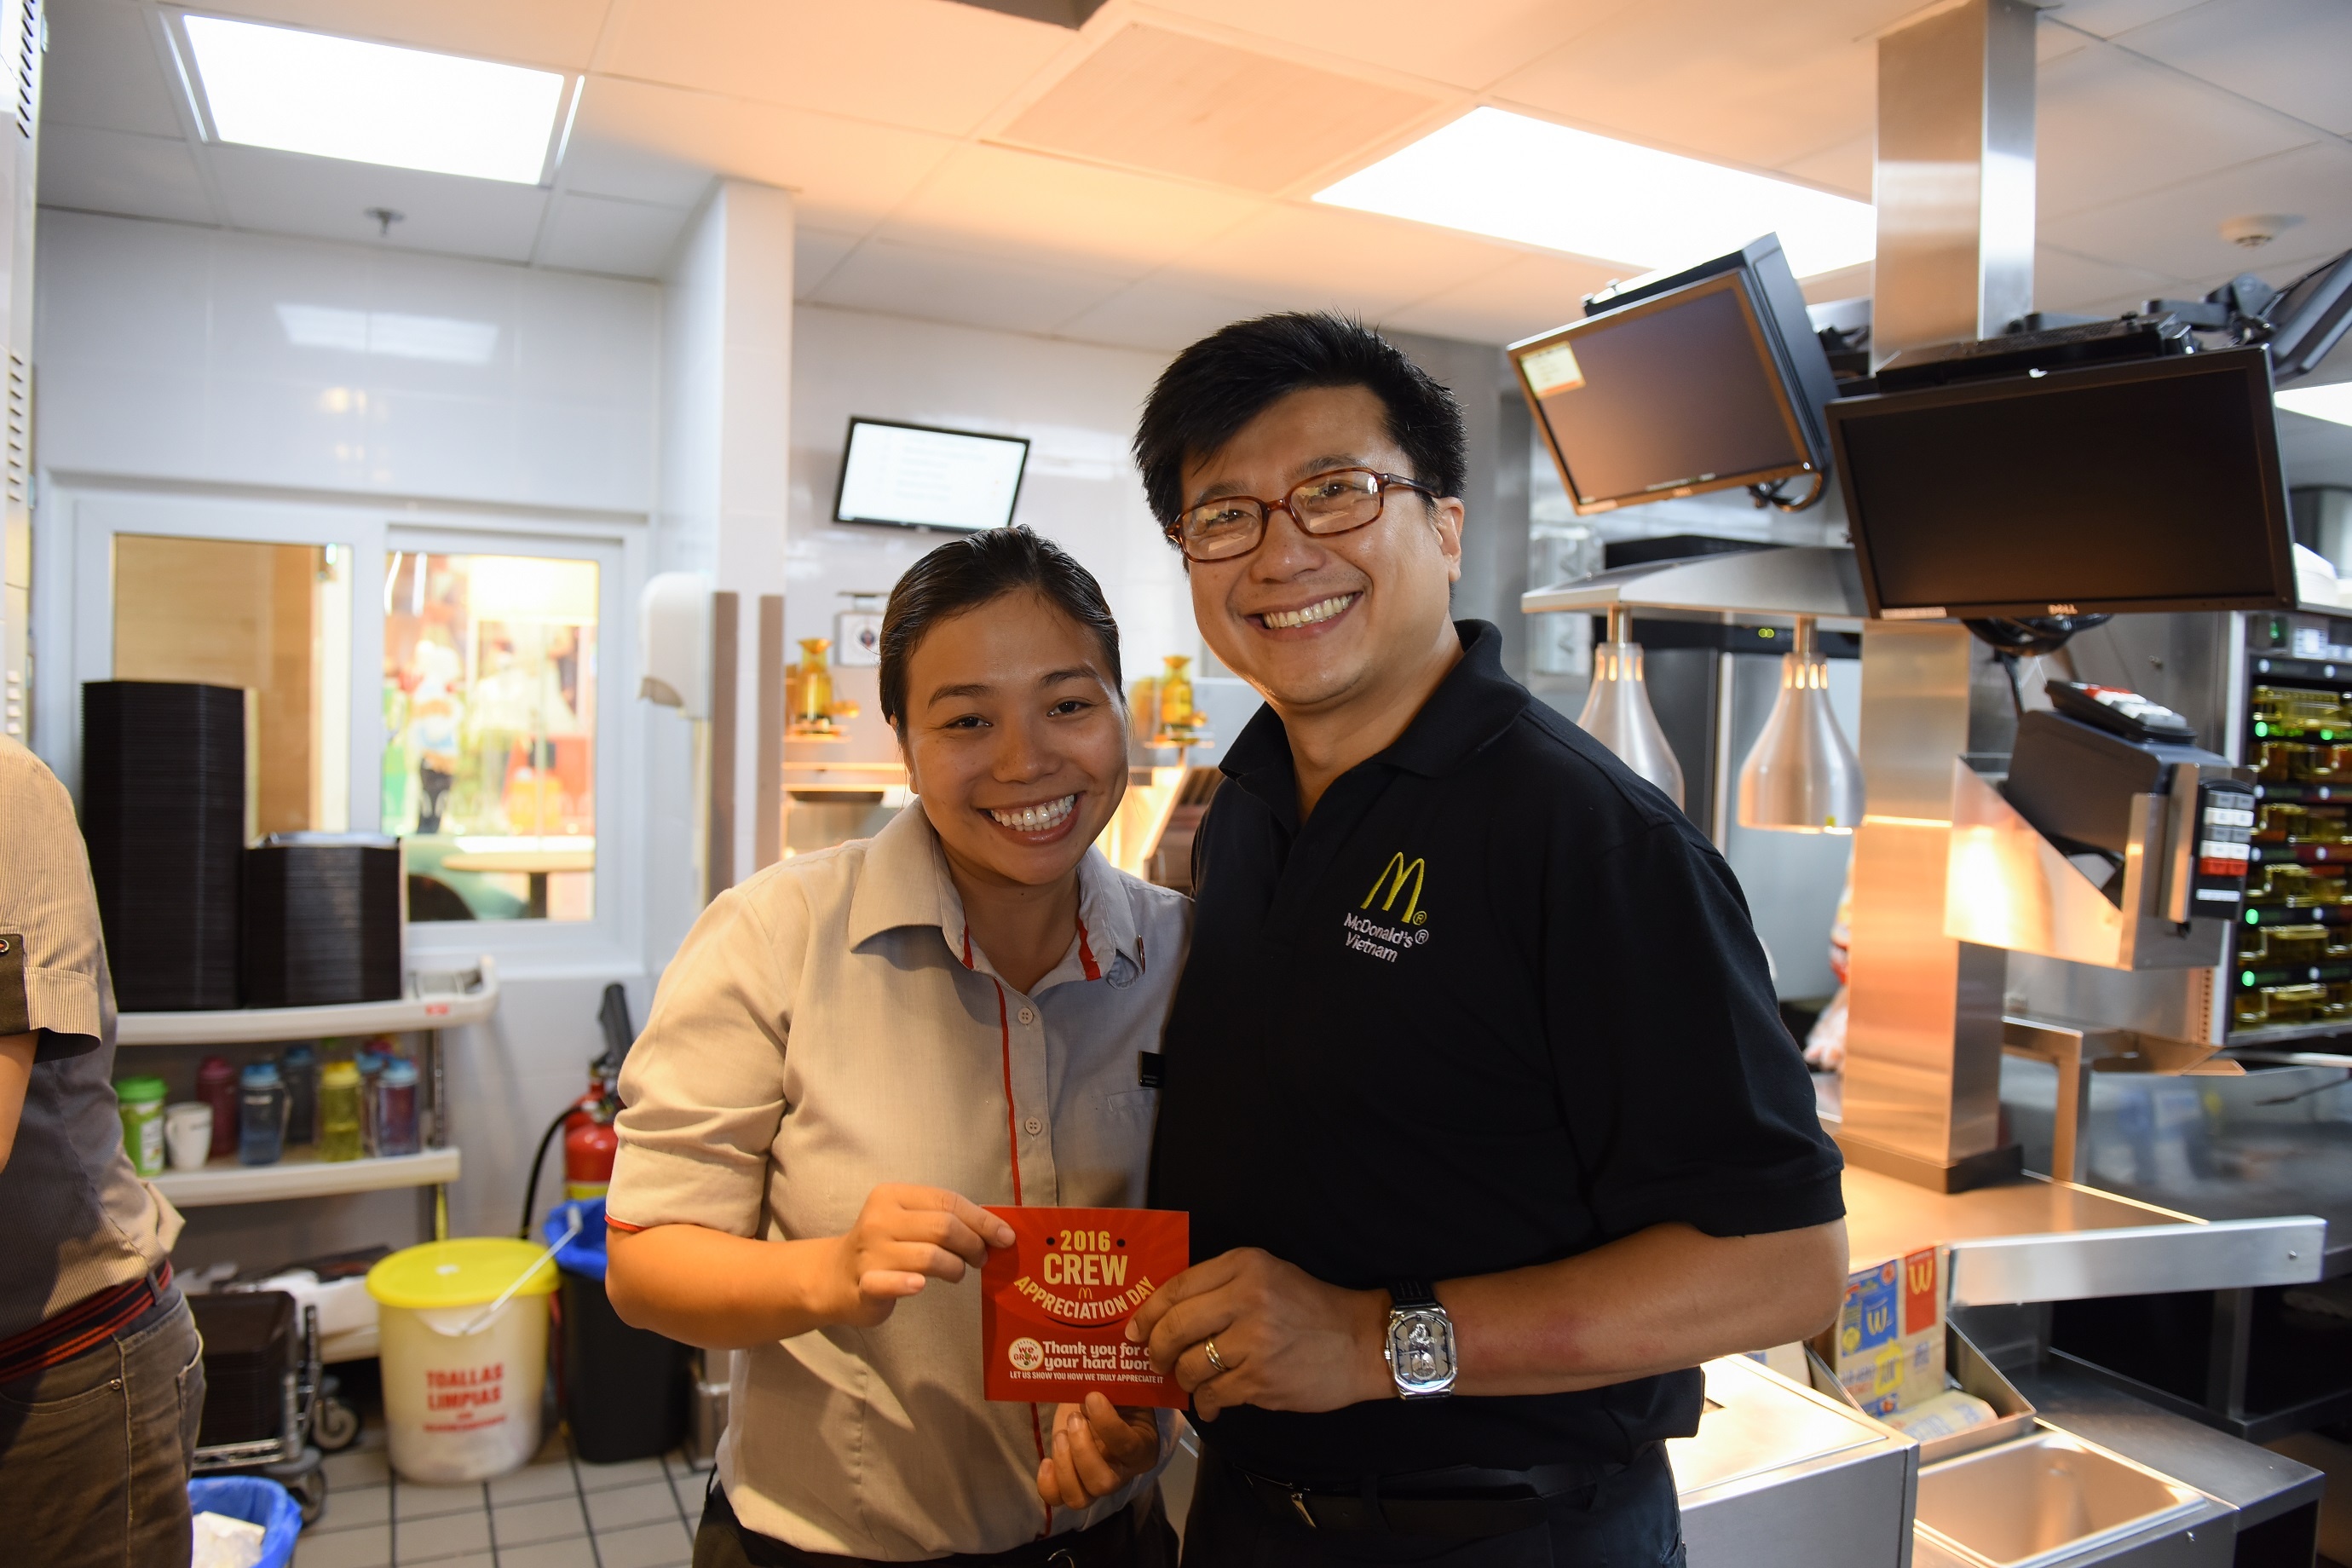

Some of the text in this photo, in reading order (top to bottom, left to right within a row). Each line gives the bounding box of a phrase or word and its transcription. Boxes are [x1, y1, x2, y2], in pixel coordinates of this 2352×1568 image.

[1346, 931, 1398, 963] Vietnam
[1060, 1230, 1110, 1252] 2016
[1043, 1253, 1128, 1286] CREW
[1012, 1275, 1156, 1320] APPRECIATION DAY
[1042, 1340, 1087, 1355] Thank
[1090, 1345, 1116, 1358] you
[1119, 1341, 1141, 1359] for
[1044, 1357, 1080, 1371] your
[1082, 1355, 1116, 1370] hard
[1120, 1358, 1150, 1370] wor
[1010, 1370, 1164, 1385] LET US SHOW YOU HOW WE TRULY APPRECIATE IT
